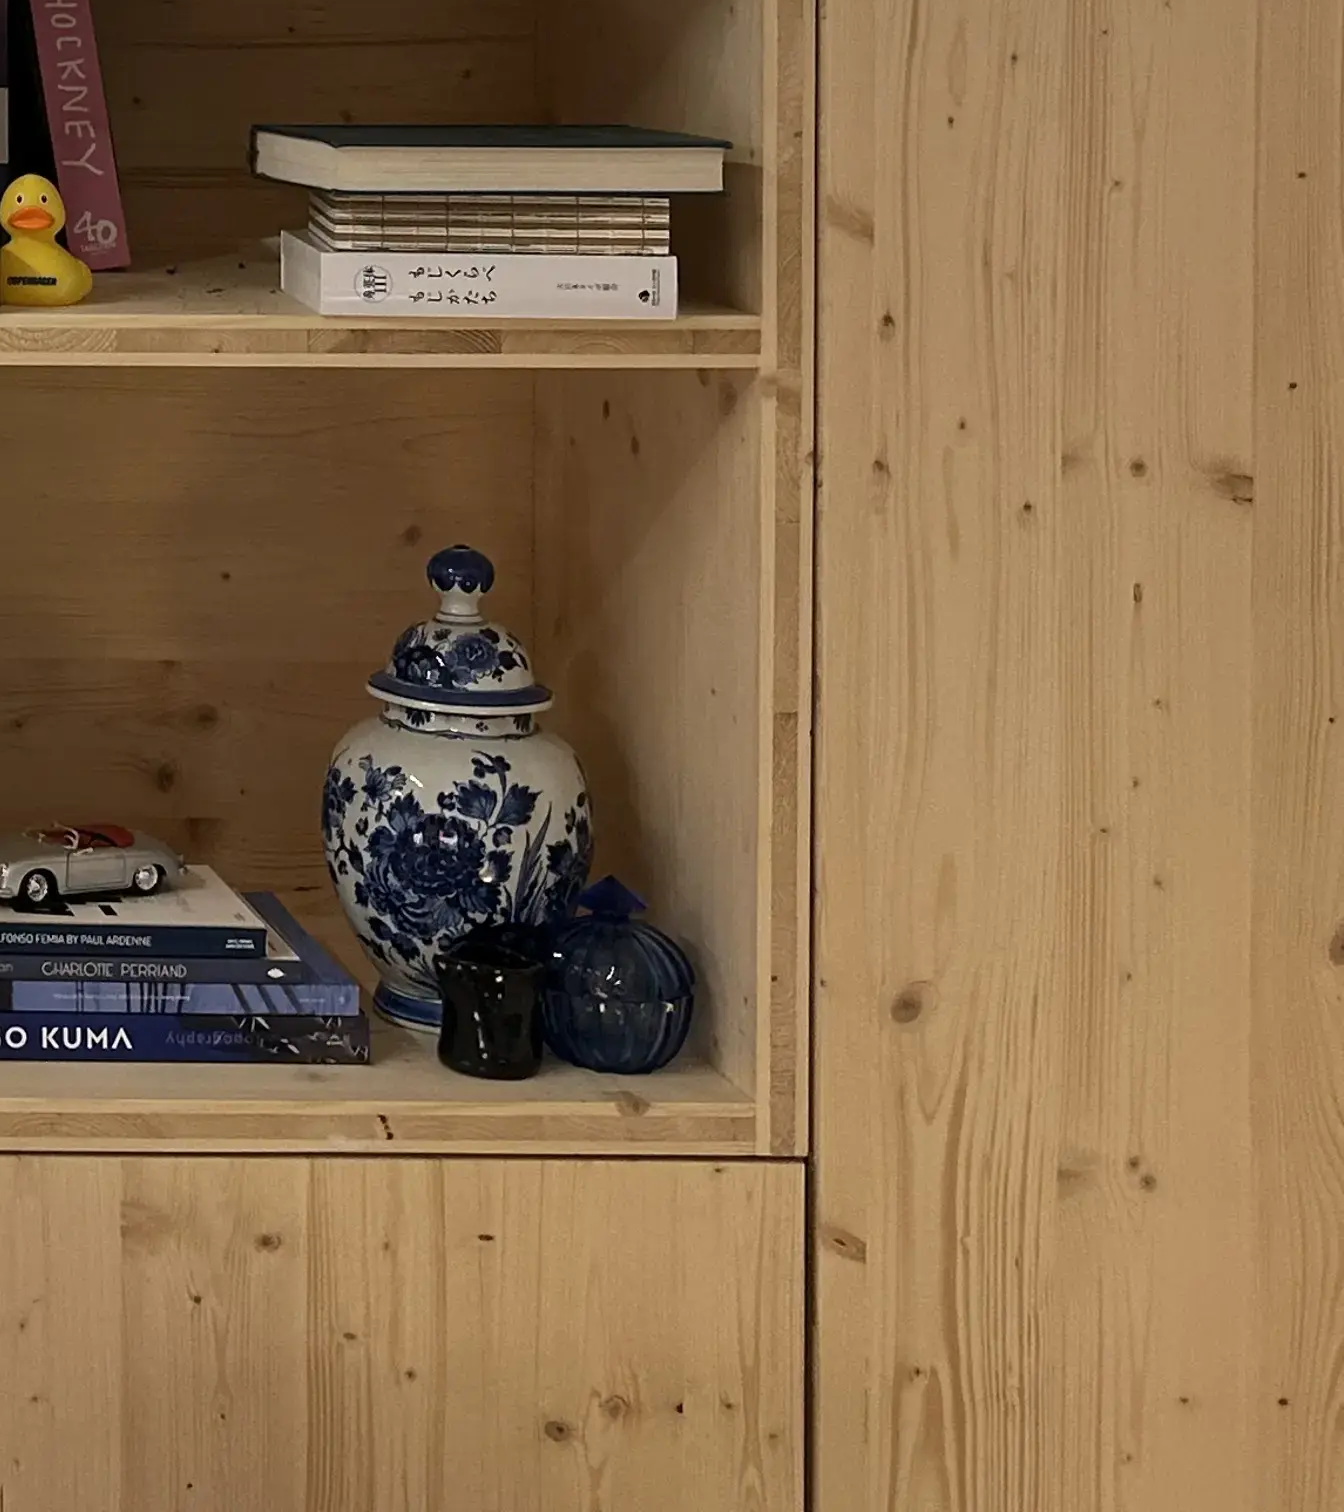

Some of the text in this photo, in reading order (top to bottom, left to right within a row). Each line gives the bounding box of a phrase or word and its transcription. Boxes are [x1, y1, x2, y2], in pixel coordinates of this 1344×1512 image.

[73, 210, 119, 245] 40
[66, 934, 79, 945] BY
[80, 934, 104, 947] PAUL
[105, 935, 152, 948] ARDENNE
[120, 962, 188, 979] PERRIAND
[41, 1026, 133, 1050] KUMA
